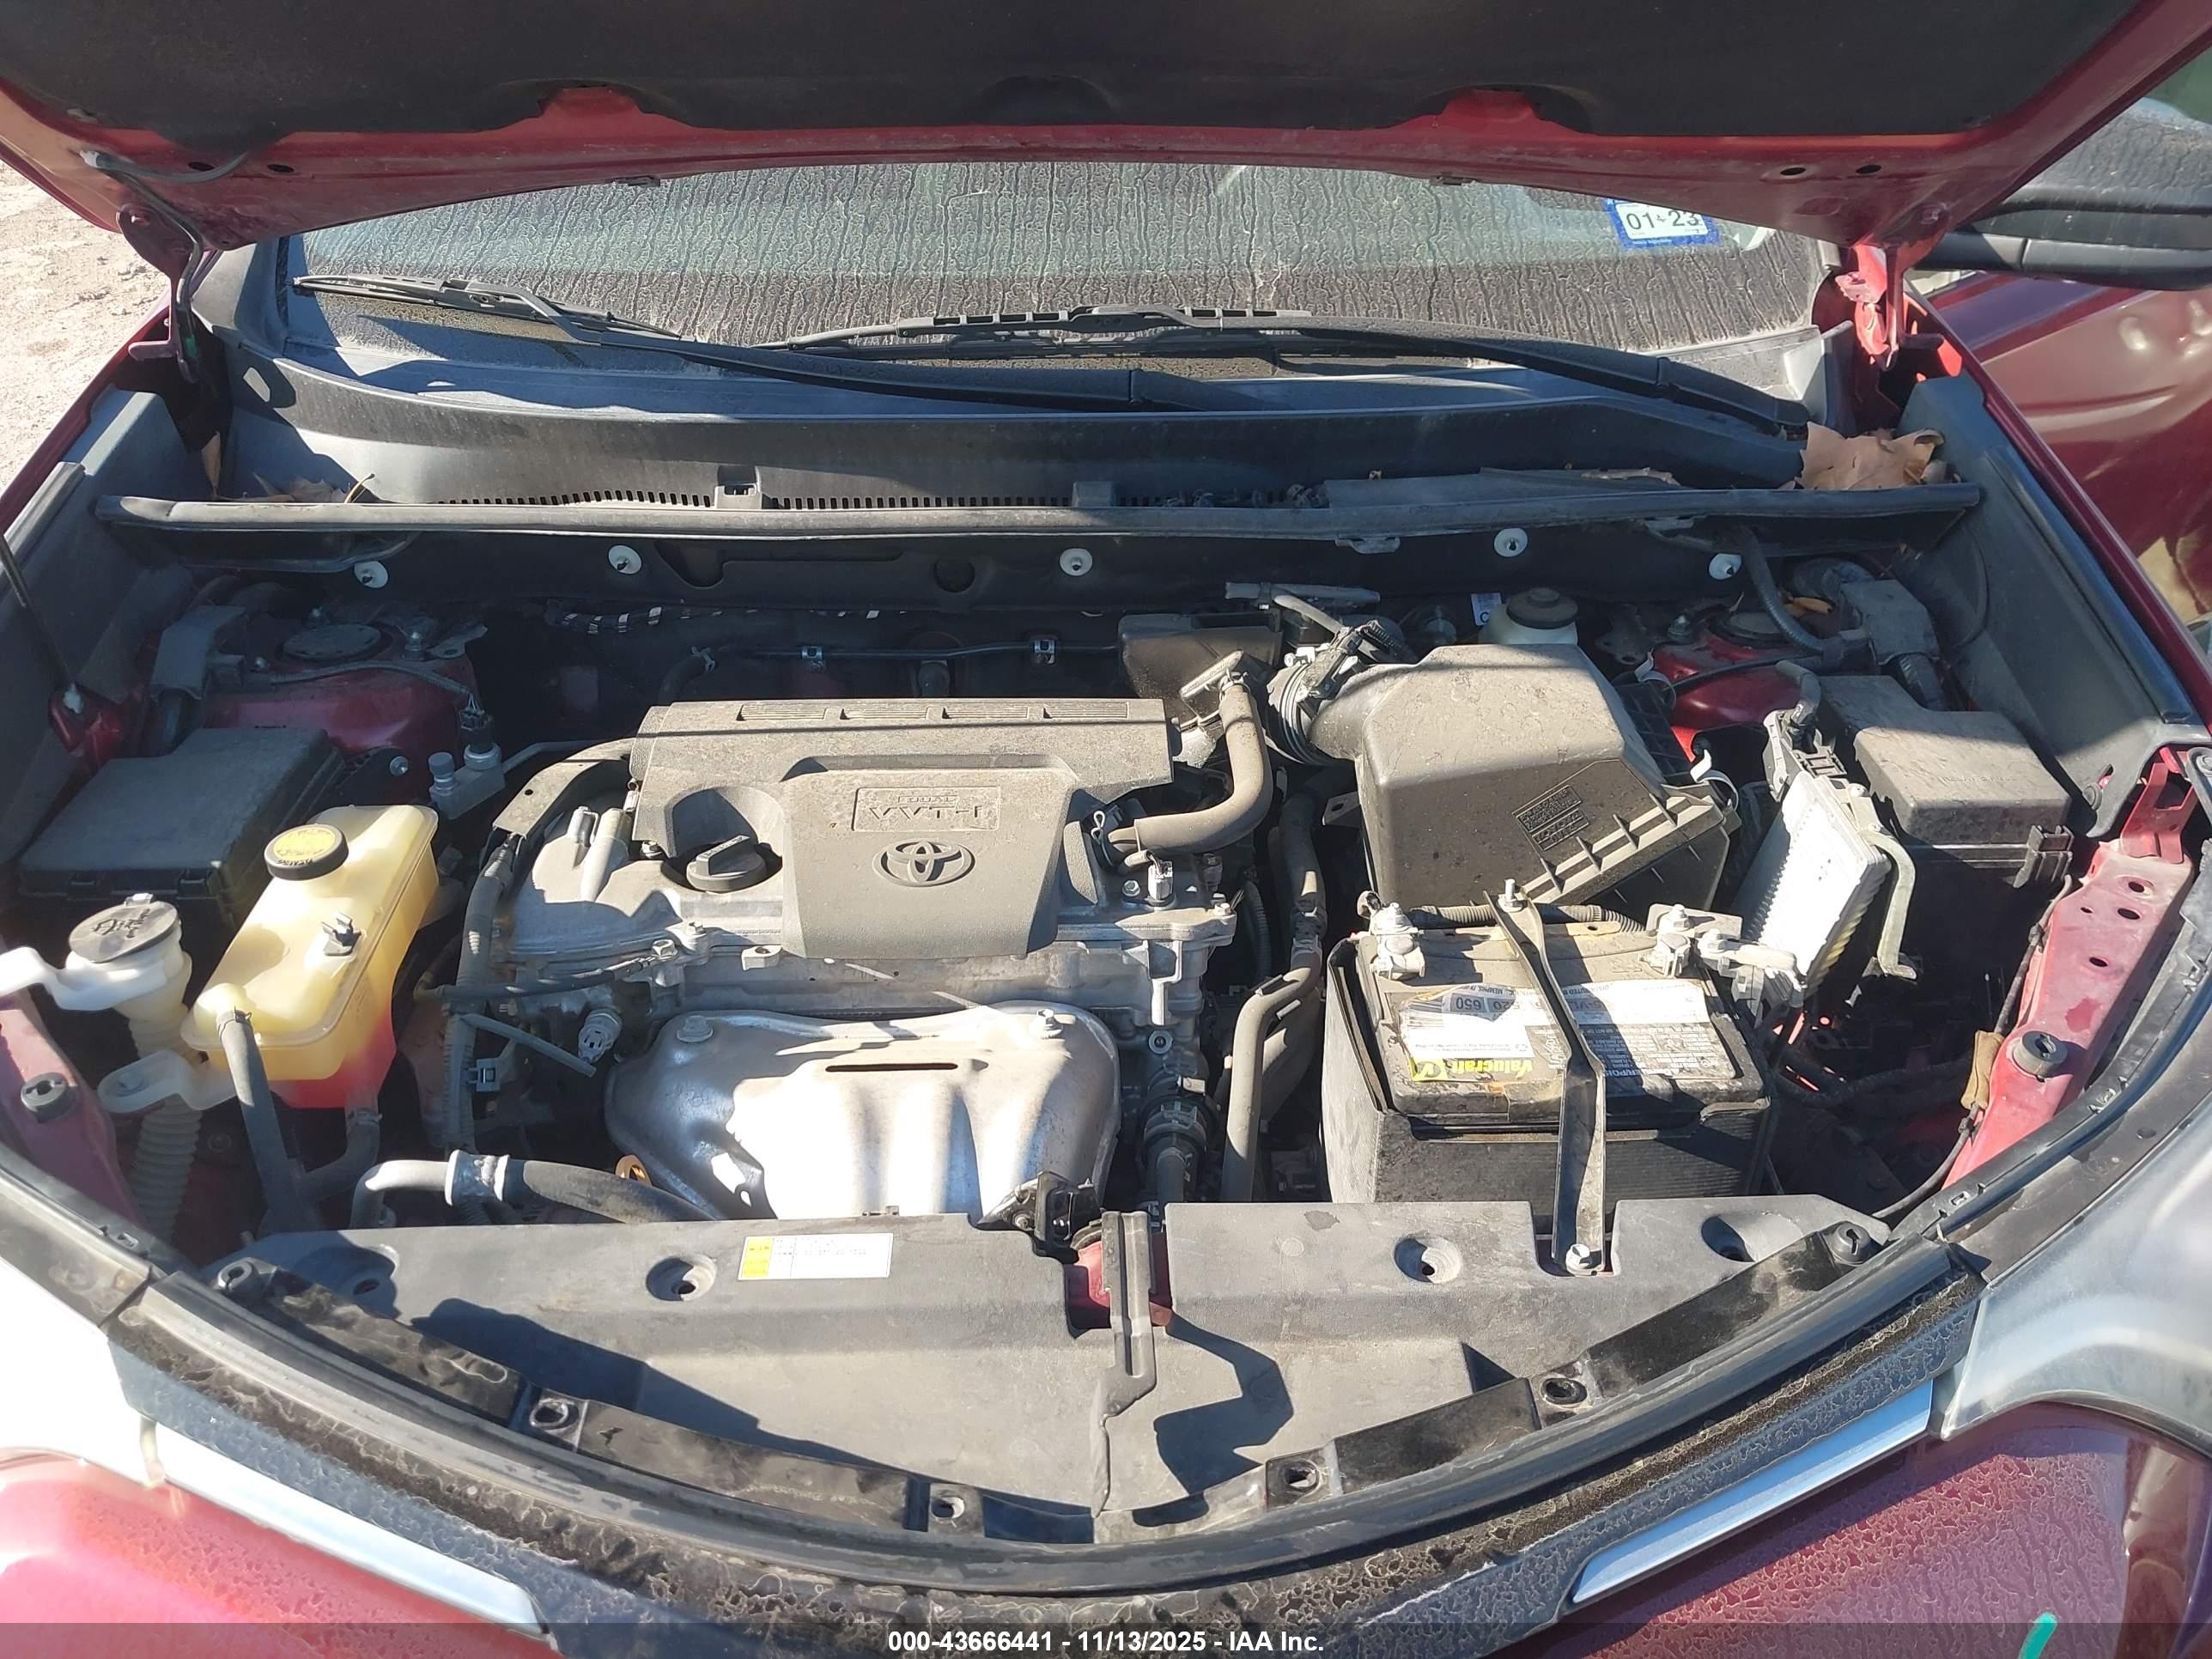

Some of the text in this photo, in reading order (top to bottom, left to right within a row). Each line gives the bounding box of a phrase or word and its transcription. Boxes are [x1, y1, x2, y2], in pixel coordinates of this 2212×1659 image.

[1626, 210, 1703, 230] 01 23
[1455, 997, 1481, 1011] 650
[1451, 1060, 1533, 1079] Valucraft
